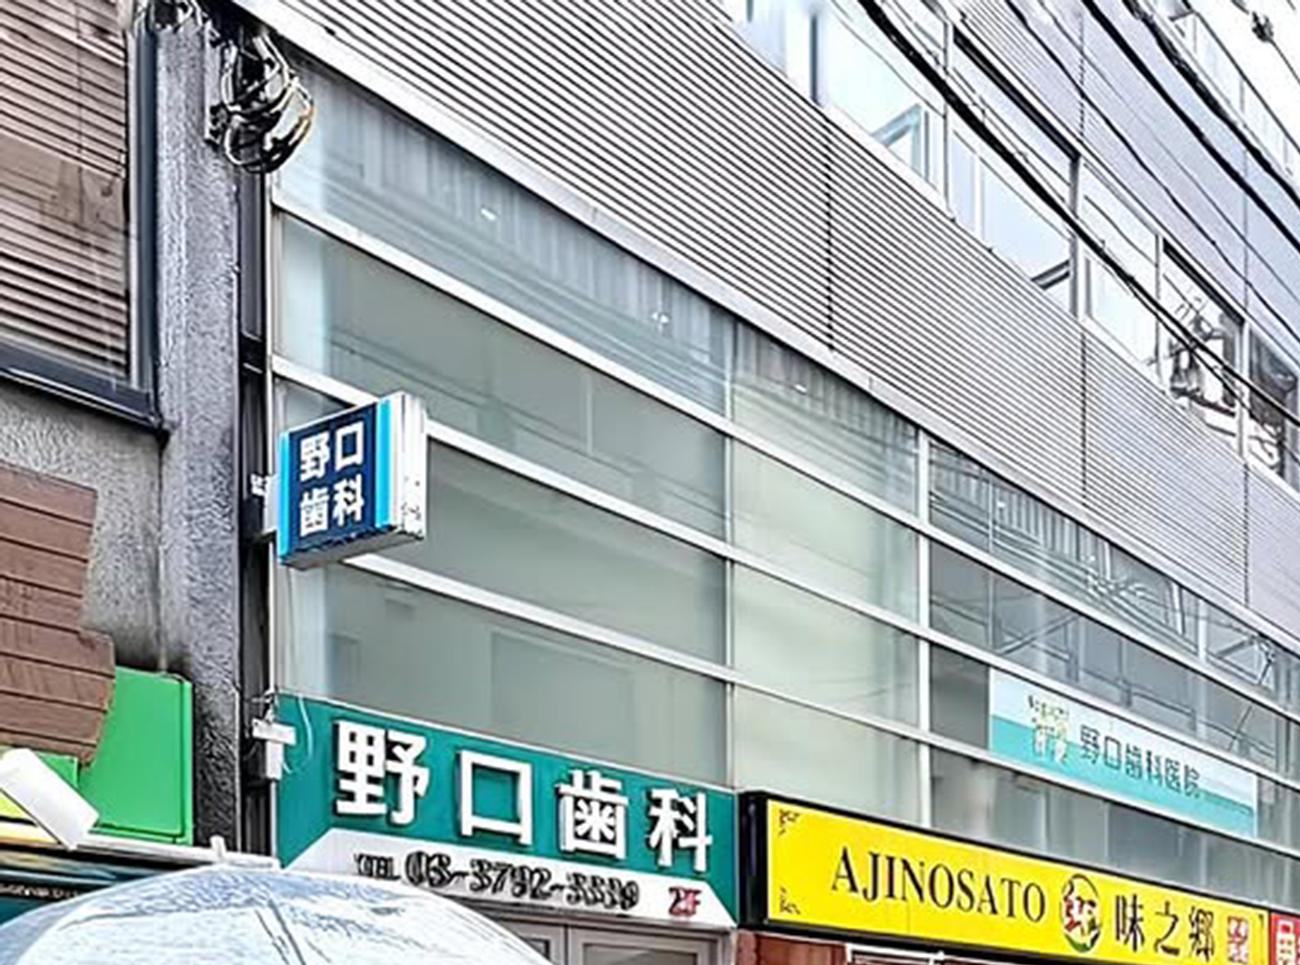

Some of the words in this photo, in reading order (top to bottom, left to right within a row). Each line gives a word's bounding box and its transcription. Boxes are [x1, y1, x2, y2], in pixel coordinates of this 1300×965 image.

[300, 420, 364, 482] 野口
[299, 473, 364, 538] 歯科
[335, 720, 712, 872] 野口歯科
[1080, 724, 1200, 799] 野口歯科医院
[831, 846, 1046, 923] AJINOSATO
[1115, 893, 1216, 962] 味之郷
